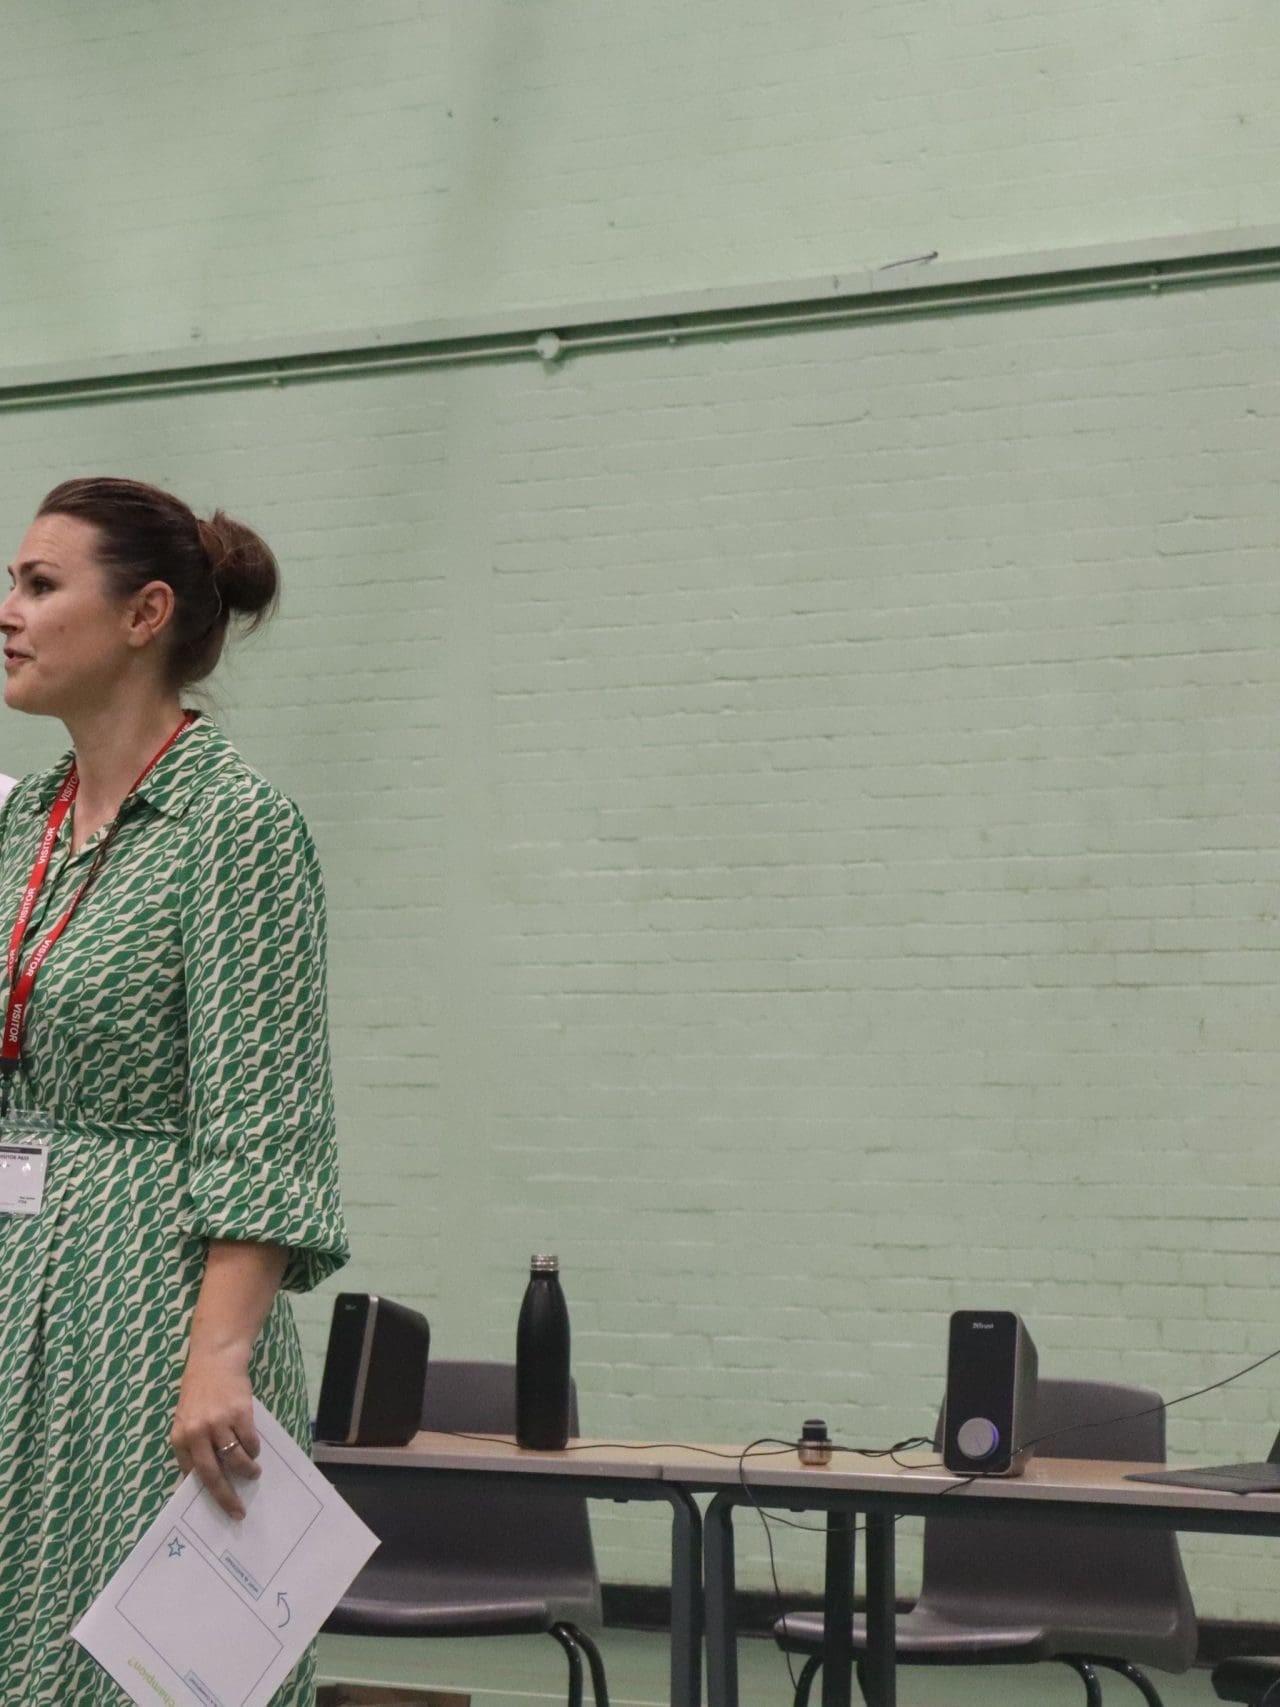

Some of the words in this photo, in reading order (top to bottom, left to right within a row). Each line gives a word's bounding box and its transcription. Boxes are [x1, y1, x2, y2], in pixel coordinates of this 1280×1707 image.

[37, 827, 56, 865] VISITOR
[17, 887, 37, 925] VISITOR
[25, 938, 53, 977] VISITOR
[8, 1003, 23, 1043] VISITOR
